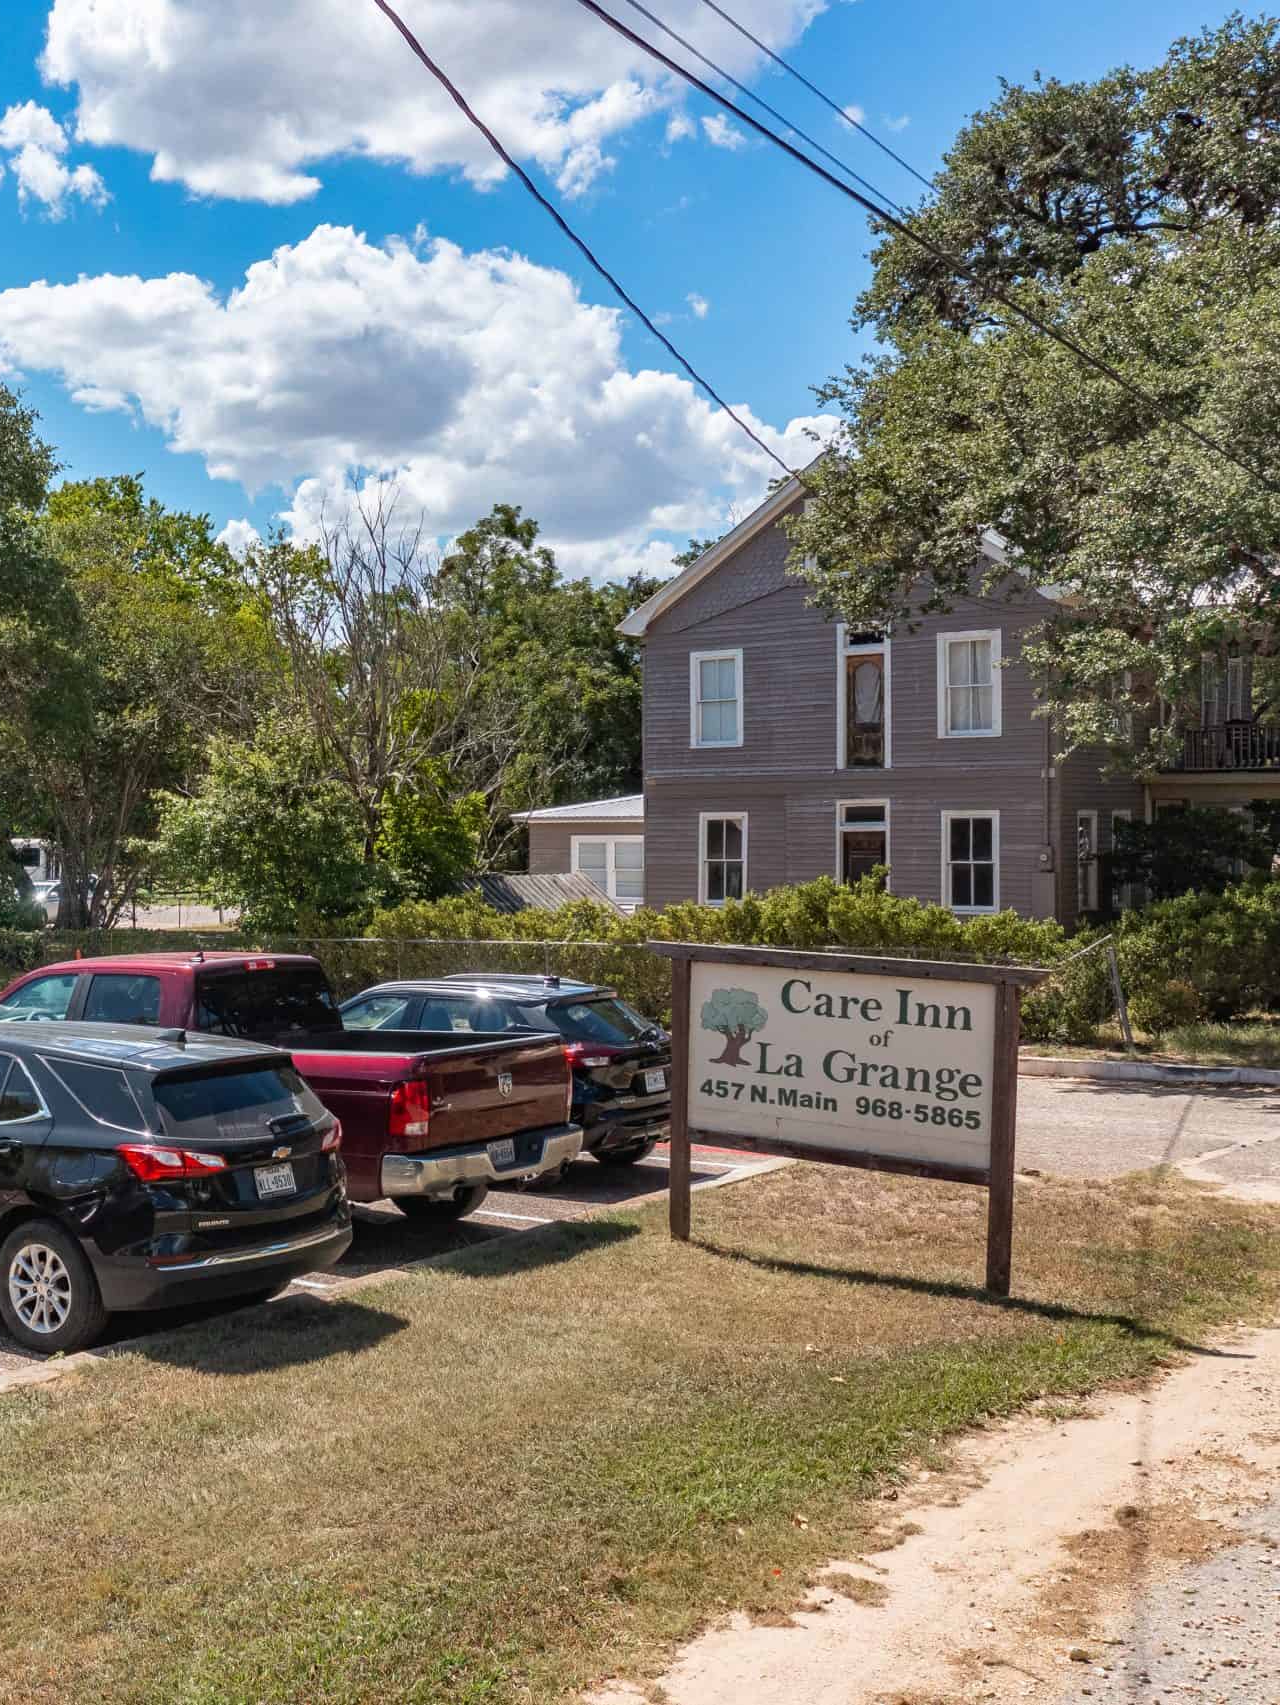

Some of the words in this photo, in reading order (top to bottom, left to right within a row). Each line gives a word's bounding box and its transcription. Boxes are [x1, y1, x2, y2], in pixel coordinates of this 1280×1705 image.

[781, 979, 882, 1022] Care
[895, 988, 972, 1031] Inn
[869, 1030, 894, 1047] of
[700, 1079, 745, 1100] 457
[755, 1042, 805, 1078] La
[822, 1050, 982, 1101] Grange
